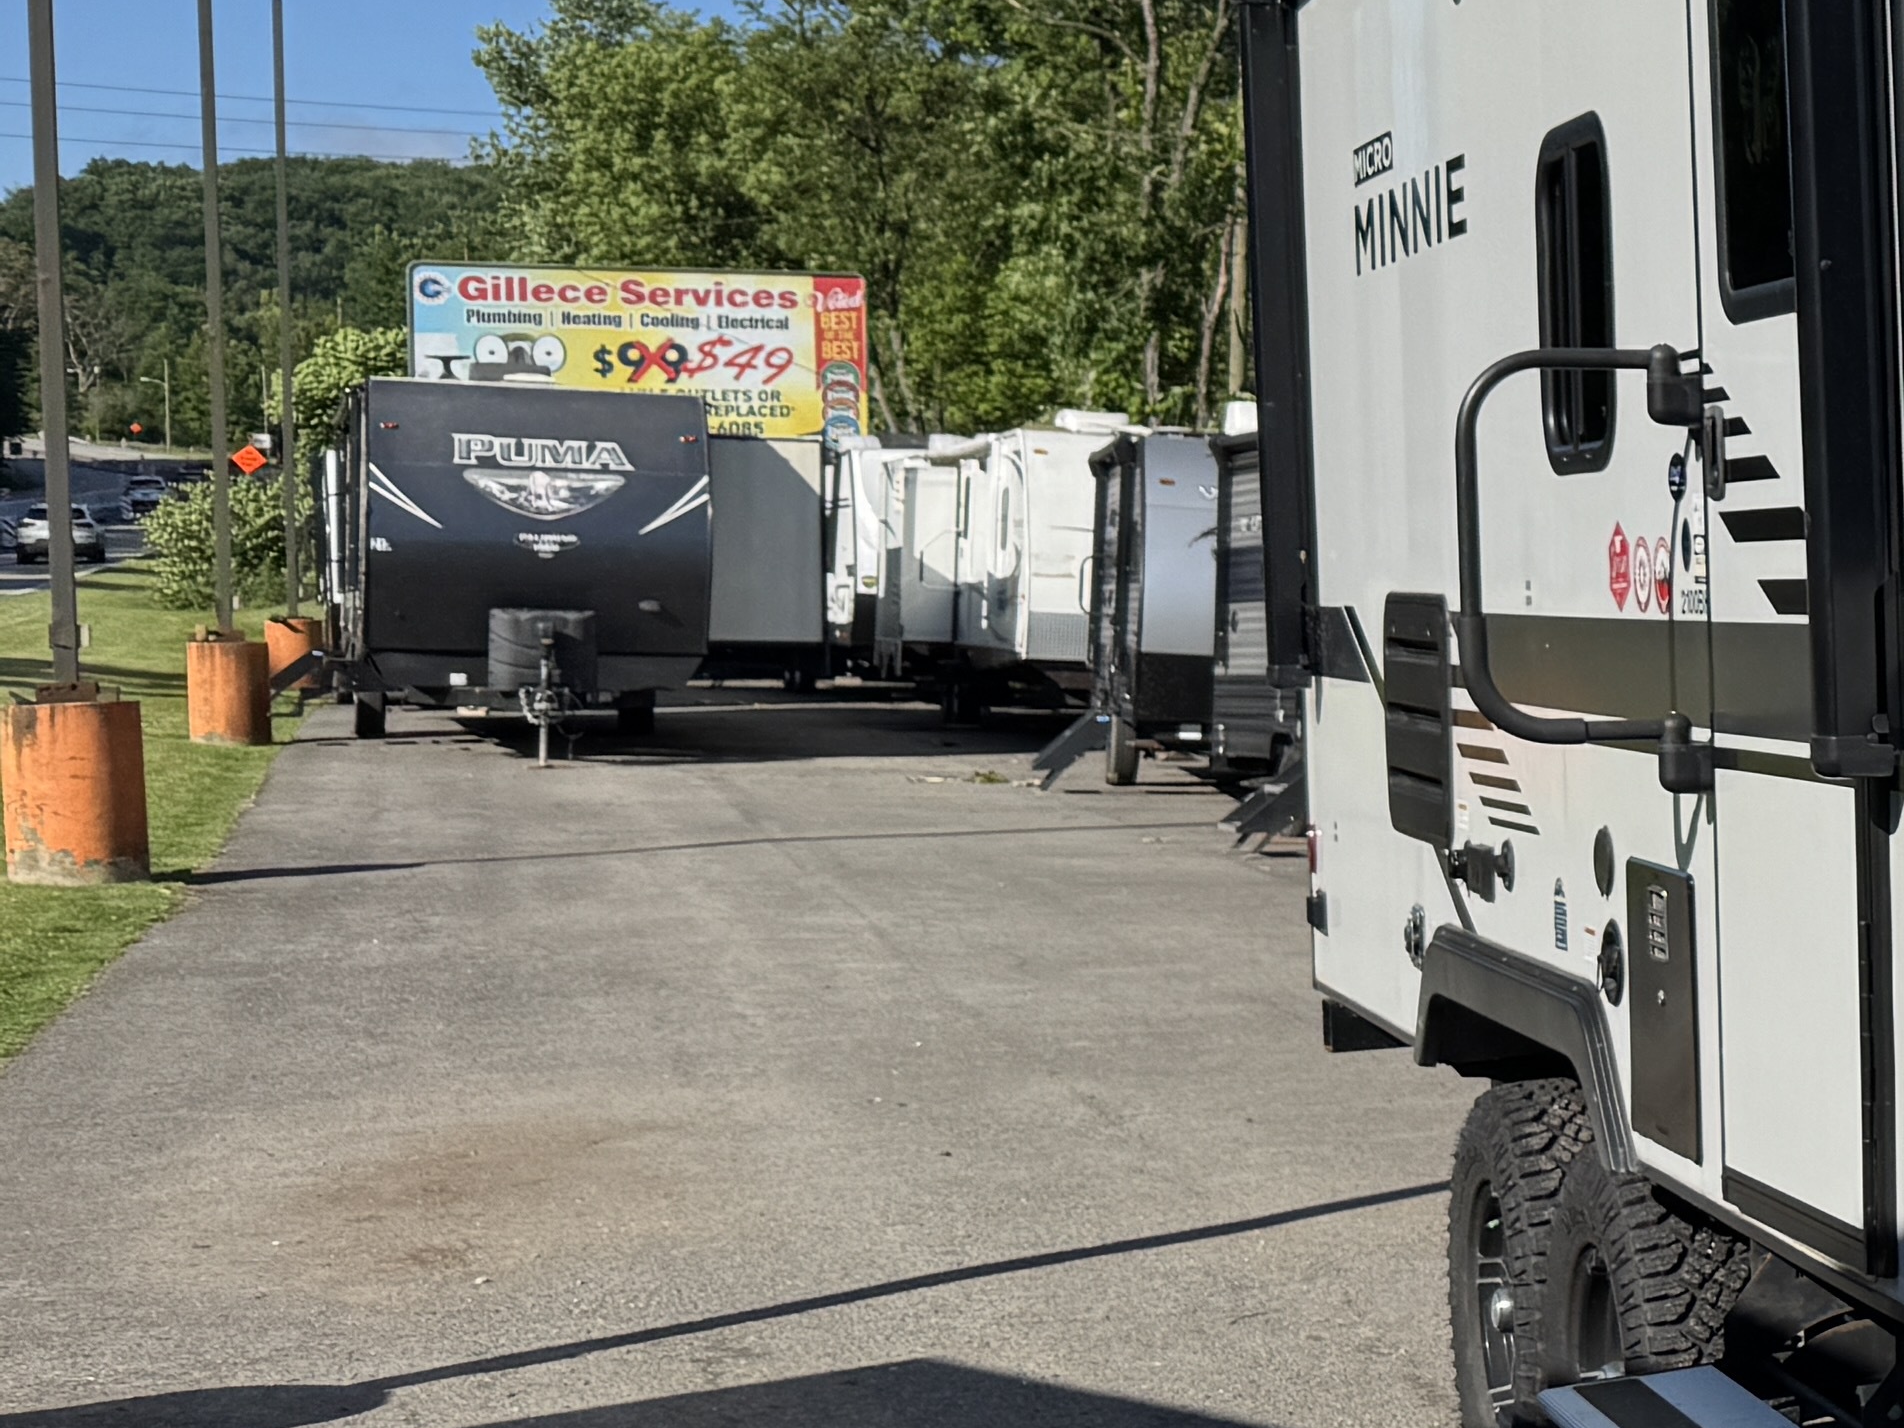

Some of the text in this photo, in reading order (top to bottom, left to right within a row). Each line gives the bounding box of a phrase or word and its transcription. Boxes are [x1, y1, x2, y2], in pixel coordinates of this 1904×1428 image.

[1354, 136, 1392, 181] MICRO
[1354, 152, 1467, 277] MINNIE
[457, 275, 799, 309] Gillece Services
[466, 308, 790, 330] Plumbing Heating Cooling Electrical
[820, 312, 858, 330] BEST
[681, 334, 795, 386] $49
[821, 340, 860, 360] BEST
[757, 389, 782, 403] OR
[451, 432, 636, 472] PUMA
